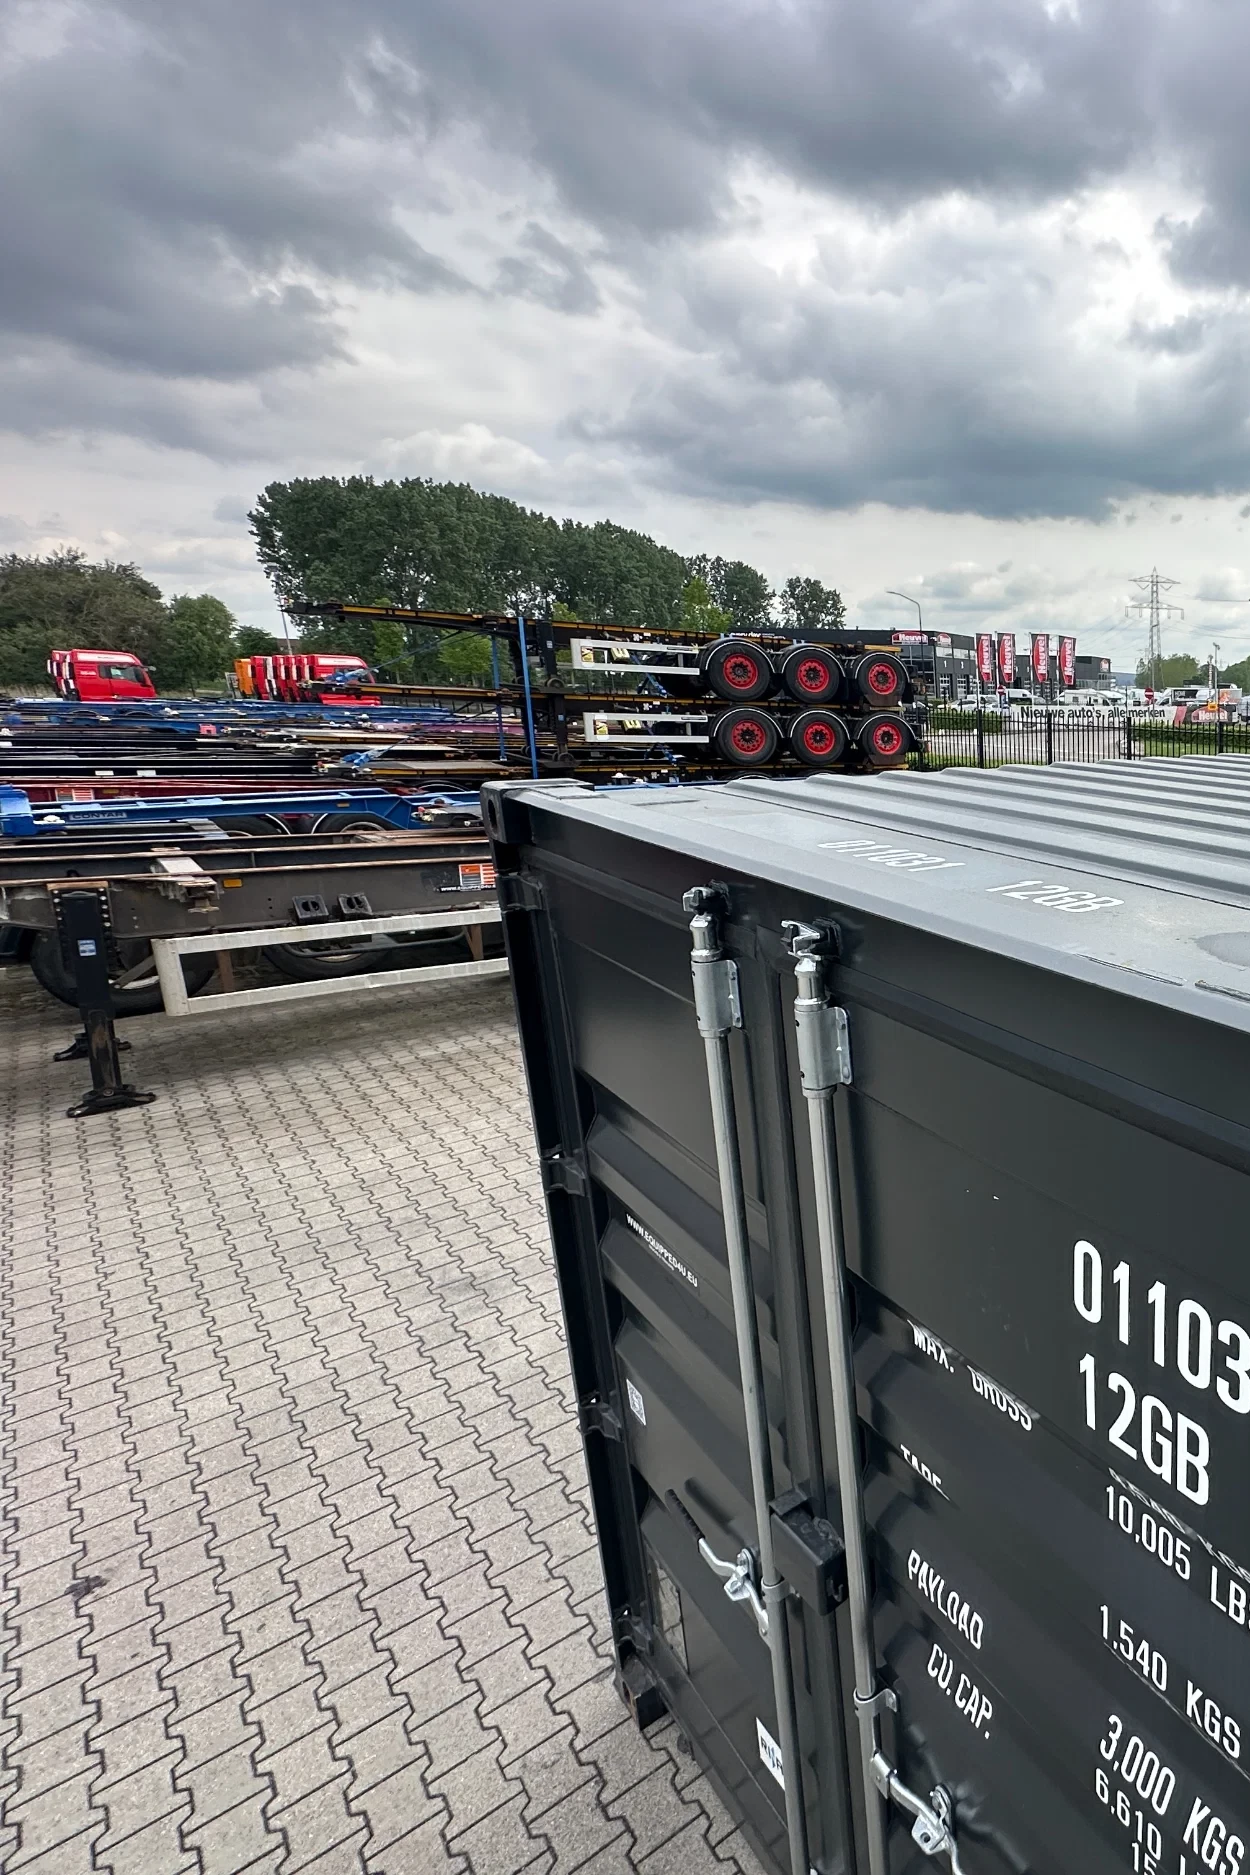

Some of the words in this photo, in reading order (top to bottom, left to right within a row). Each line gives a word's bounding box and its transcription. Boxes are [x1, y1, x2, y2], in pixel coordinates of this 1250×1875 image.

[982, 635, 991, 673] Heuvel
[1003, 635, 1012, 673] Heuvel
[1037, 635, 1046, 674] Heuvel
[1064, 638, 1073, 676] Heuvel
[1020, 706, 1065, 718] Nieuwe
[1108, 706, 1126, 718] alle
[1128, 706, 1166, 718] merken
[985, 880, 1125, 913] 12GB
[1078, 1352, 1210, 1506] 12GB
[907, 1549, 984, 1650] PAYLOAD
[1182, 1796, 1245, 1875] KGS
[1186, 1680, 1241, 1759] KGS
